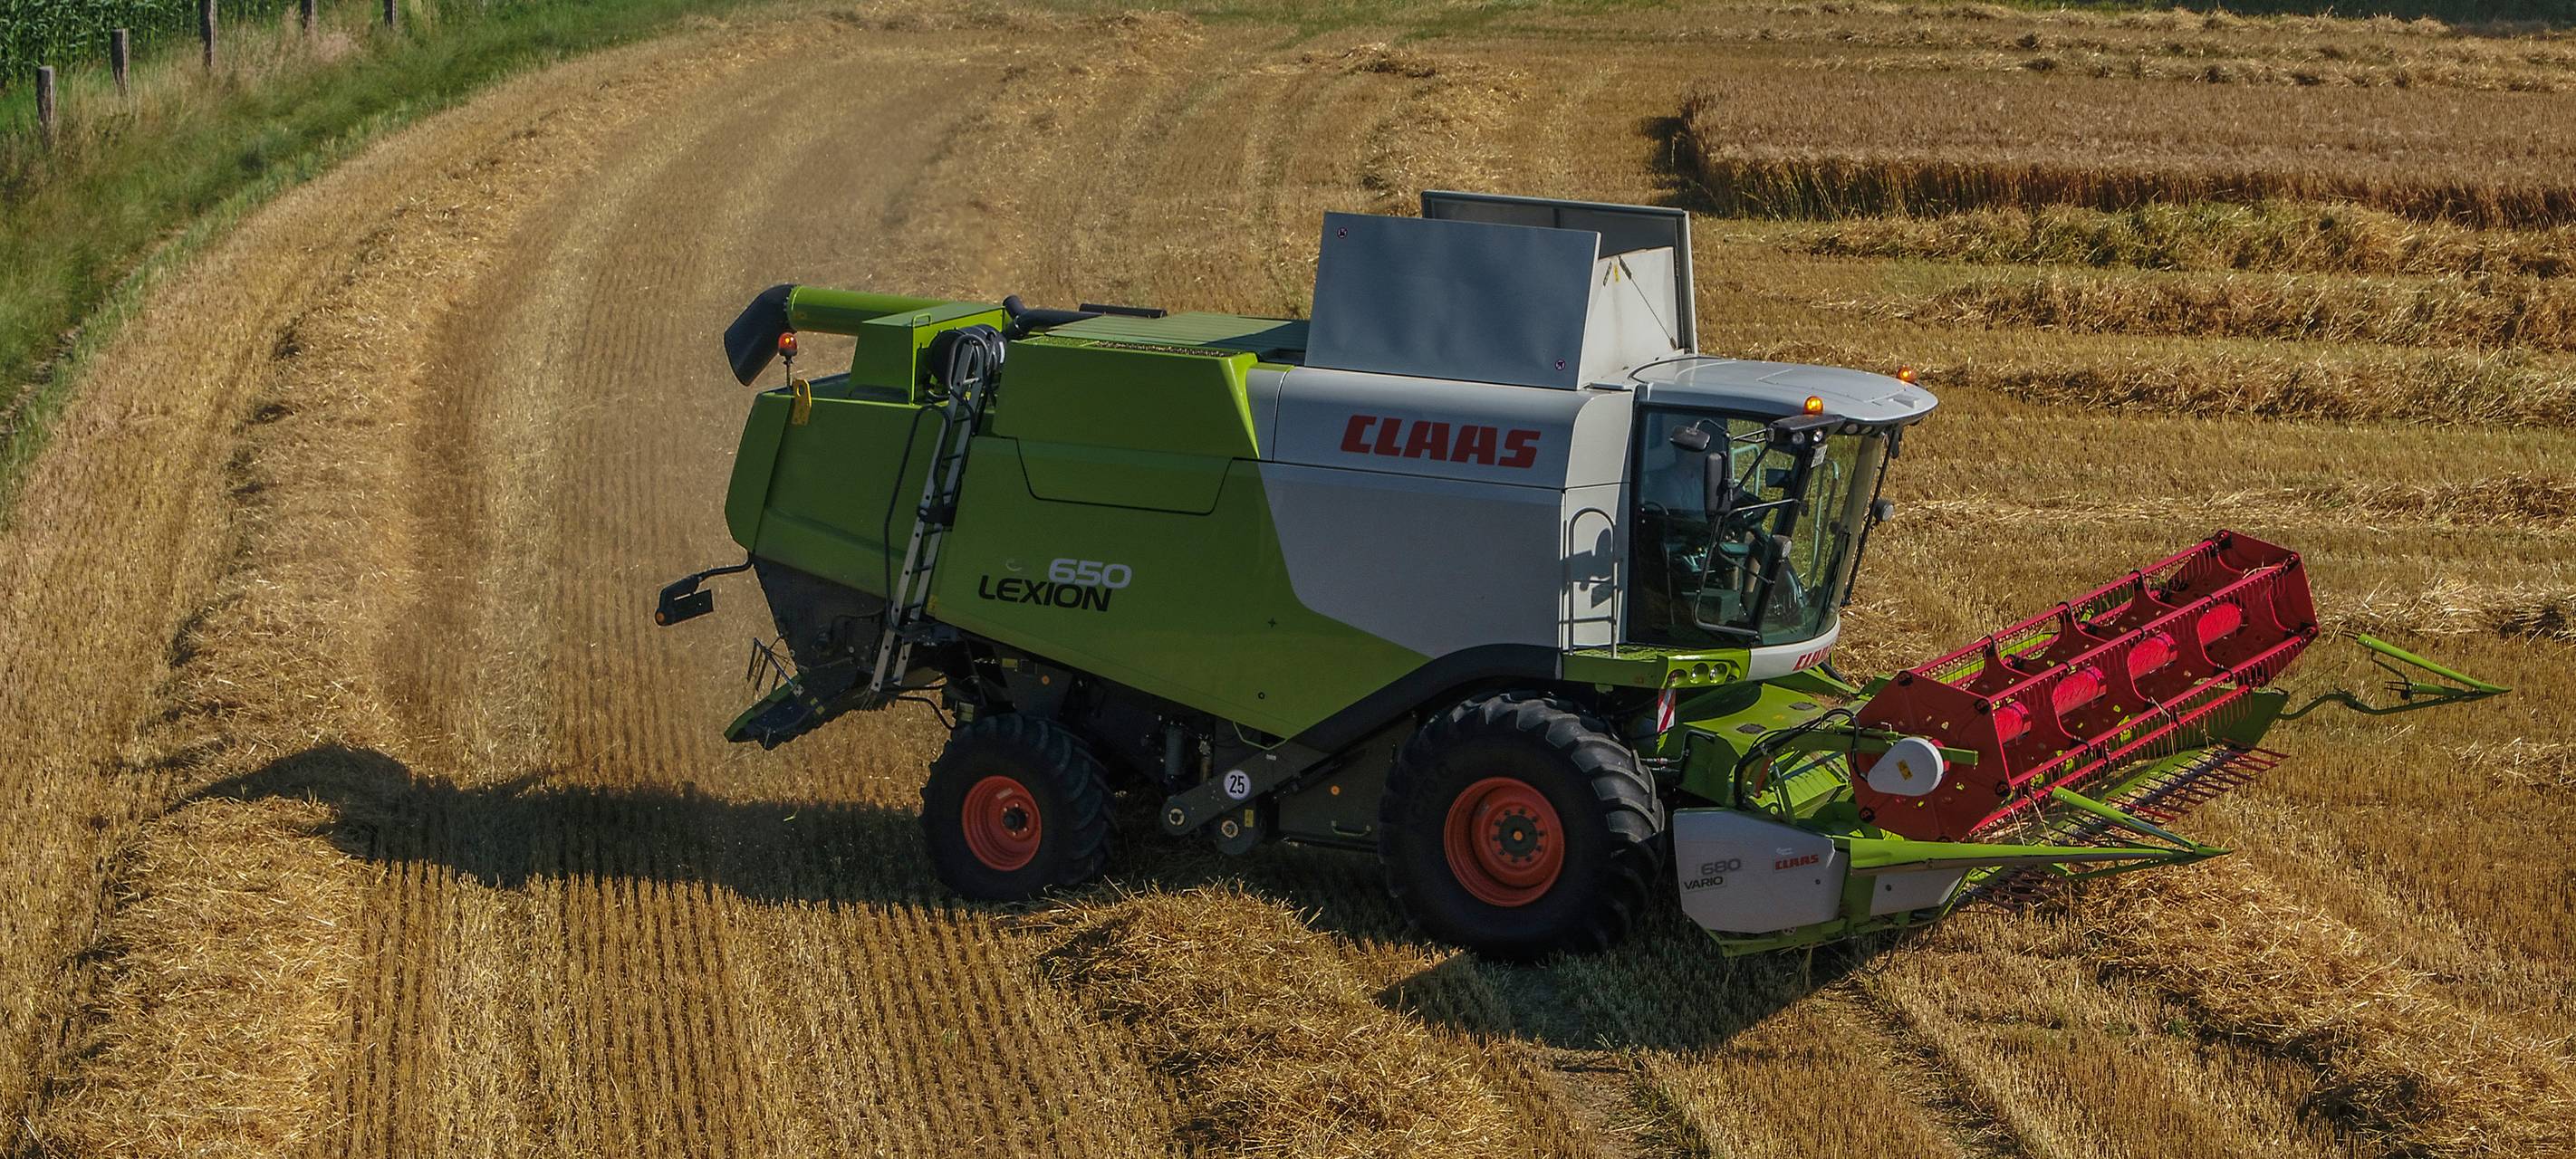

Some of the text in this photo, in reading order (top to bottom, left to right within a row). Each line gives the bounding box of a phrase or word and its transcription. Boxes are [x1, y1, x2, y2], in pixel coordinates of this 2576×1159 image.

[1341, 415, 1541, 468] CLAAS
[1048, 558, 1132, 589] 650
[978, 575, 1112, 612] LEXION
[1229, 774, 1245, 794] 25
[1701, 858, 1741, 876] 680
[1775, 854, 1819, 870] CLAAS
[1684, 876, 1724, 890] VARIO
